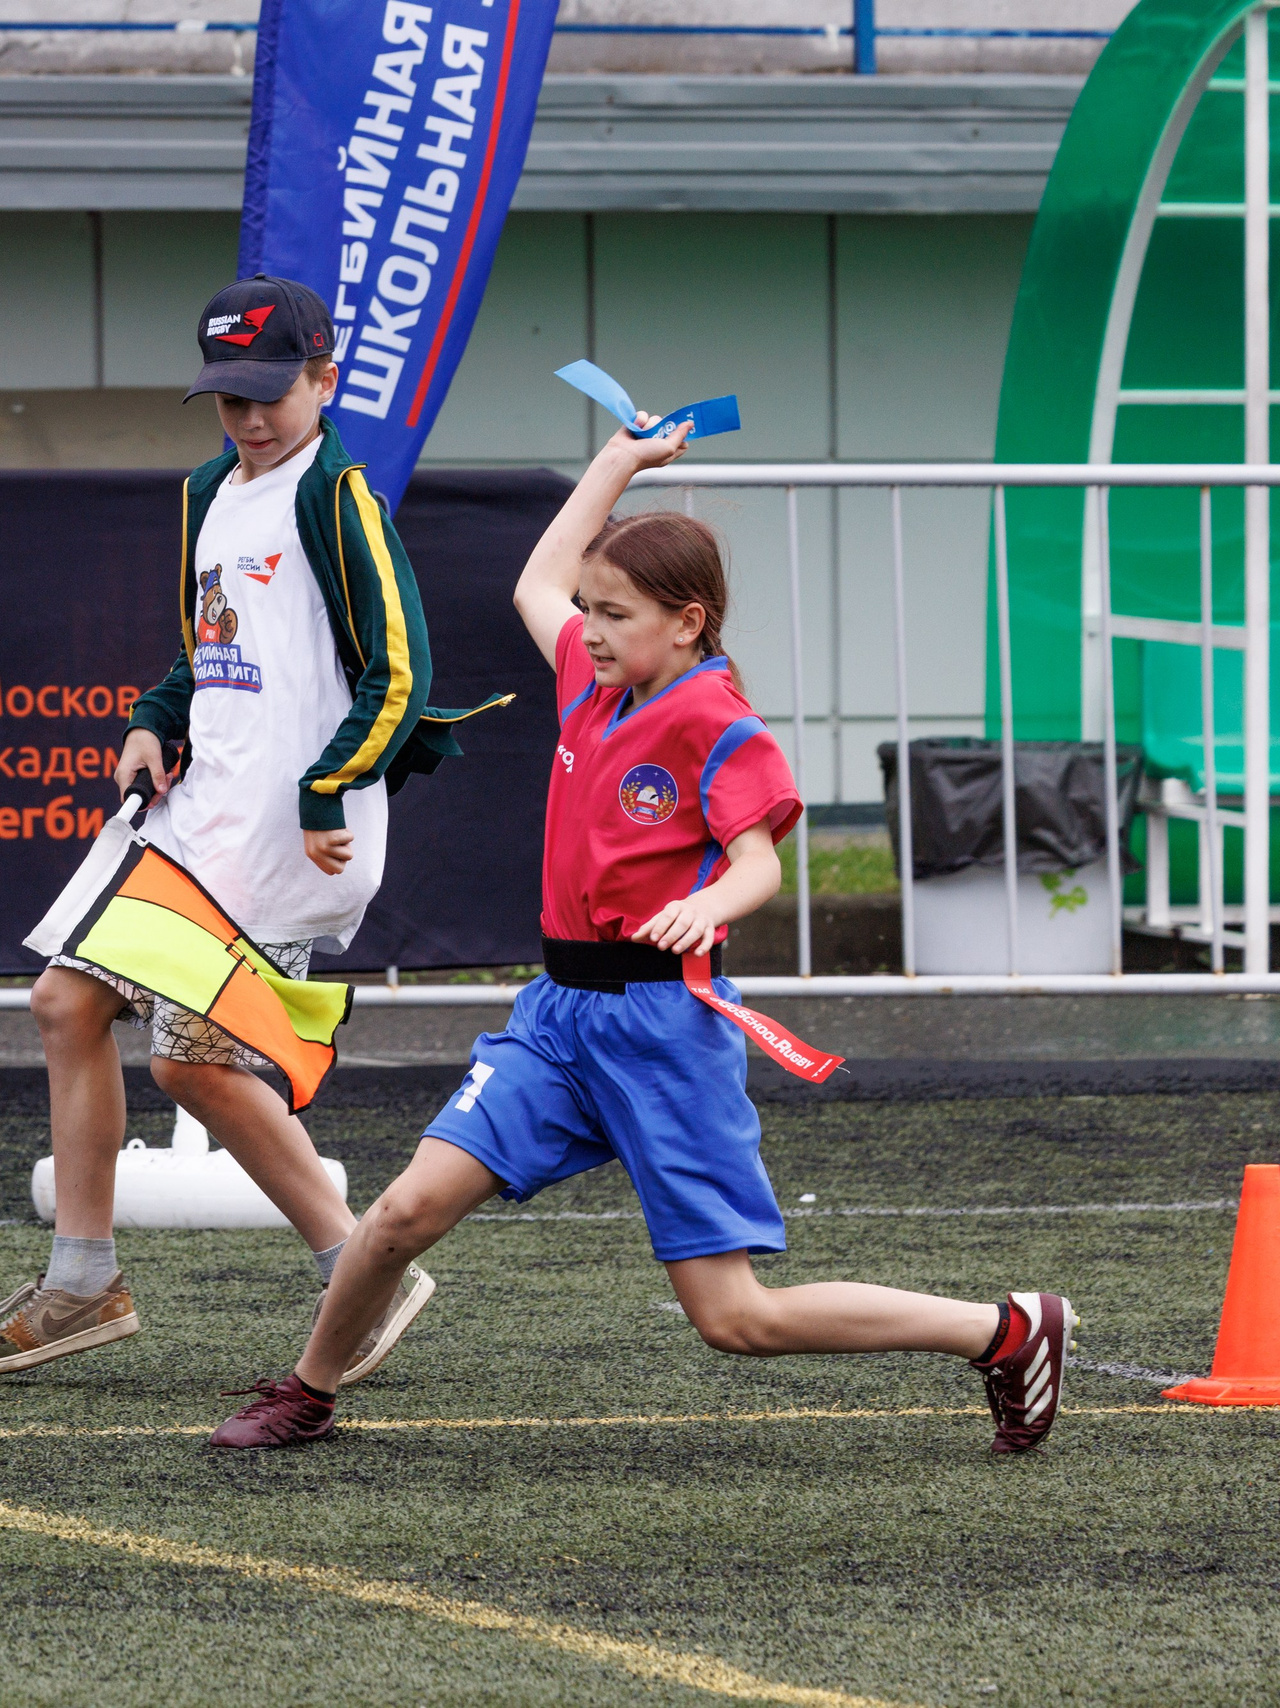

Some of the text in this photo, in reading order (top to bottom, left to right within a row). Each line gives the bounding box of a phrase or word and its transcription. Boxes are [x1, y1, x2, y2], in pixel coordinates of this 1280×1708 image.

[323, 0, 433, 406] ЕГБИЙНАЯ
[339, 23, 489, 420] ШКОЛЬНАЯ
[208, 313, 241, 328] RUSSIAN
[206, 323, 231, 337] RUGBY
[237, 563, 261, 572] РОССИИ
[227, 664, 260, 684] ЛИГА
[691, 987, 711, 995] TAG
